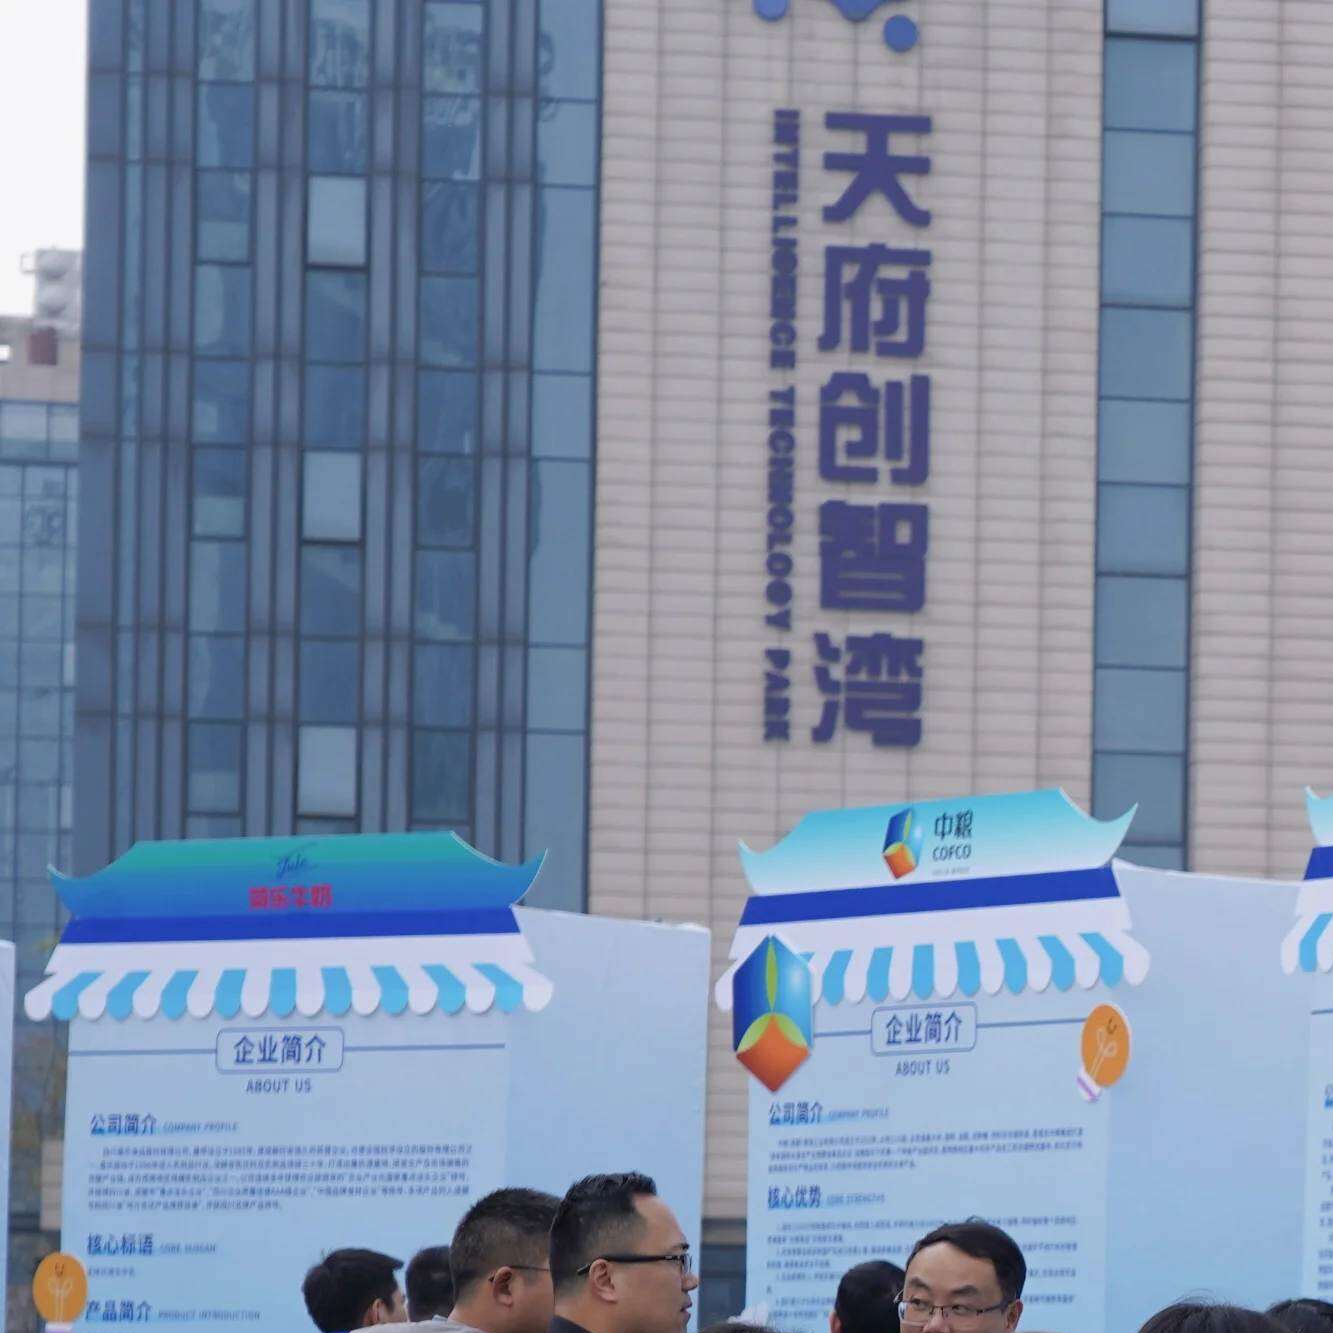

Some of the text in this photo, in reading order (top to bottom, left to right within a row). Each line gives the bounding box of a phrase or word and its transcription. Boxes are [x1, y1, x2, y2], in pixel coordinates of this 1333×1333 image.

[763, 109, 799, 742] INTELLIGENCE TECHNOLOGY PARK
[811, 112, 932, 747] 天府创智湾
[933, 809, 973, 841] 中粮
[932, 843, 972, 862] COFCO
[885, 1012, 962, 1045] 企业简介
[232, 1033, 327, 1065] 企业简介
[895, 1058, 950, 1076] ABOUT US
[246, 1078, 312, 1094] ABOUT US
[89, 1113, 158, 1136] 公司简介
[768, 1102, 824, 1126] 公司简介
[767, 1185, 822, 1209] 核心优势
[87, 1232, 153, 1256] 核心标语
[84, 1300, 152, 1323] 产品简介
